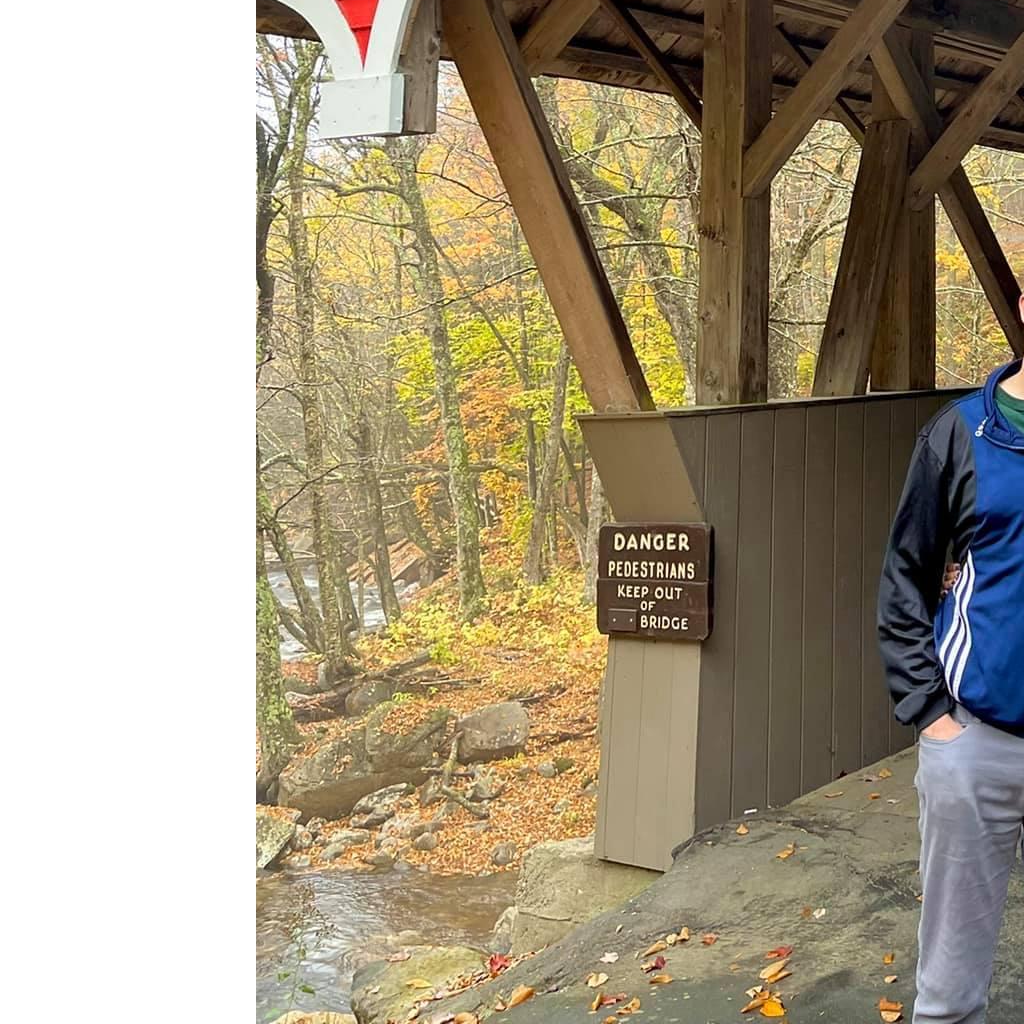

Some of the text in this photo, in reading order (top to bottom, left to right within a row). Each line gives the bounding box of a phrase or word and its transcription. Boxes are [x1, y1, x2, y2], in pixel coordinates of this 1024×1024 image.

[614, 532, 690, 551] DANGER
[608, 561, 695, 579] PEDESTRIANS
[617, 584, 683, 600] KEEP OUT
[640, 600, 656, 611] OF
[640, 615, 689, 630] BRIDGE
